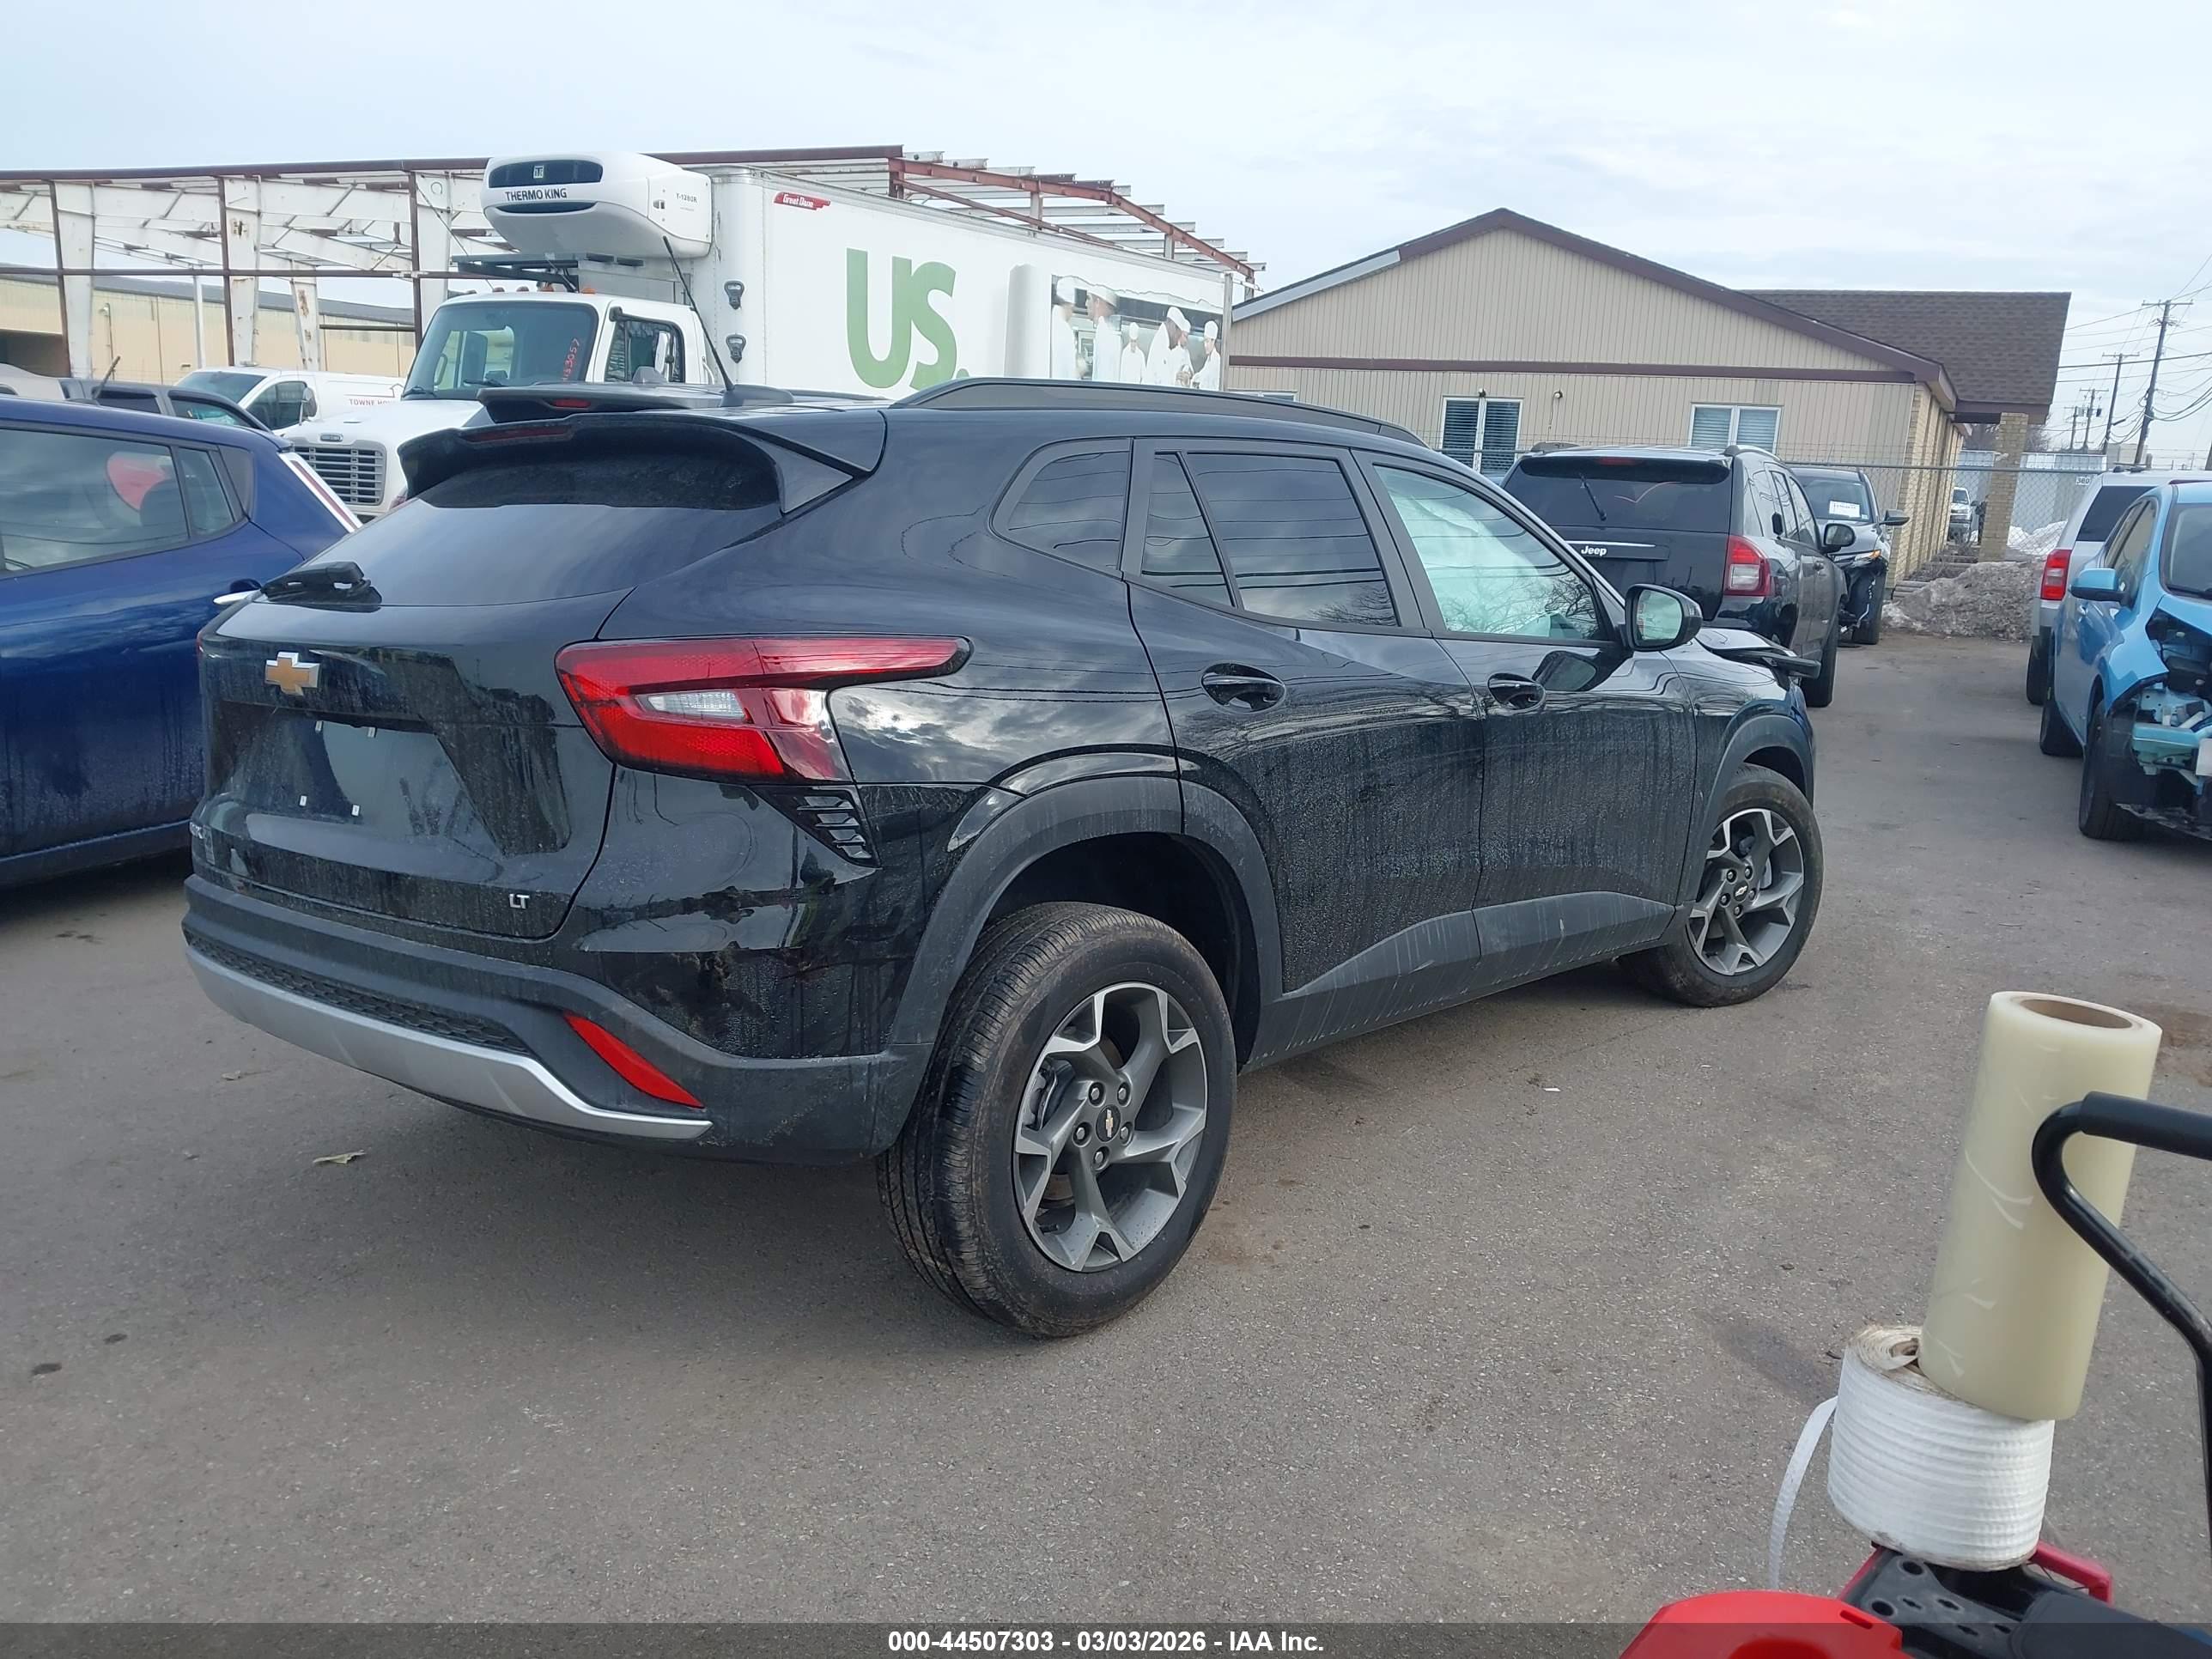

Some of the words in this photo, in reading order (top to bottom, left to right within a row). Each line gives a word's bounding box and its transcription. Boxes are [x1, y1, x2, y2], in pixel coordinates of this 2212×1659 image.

[504, 189, 544, 202] THERMO
[544, 187, 568, 200] KING
[782, 193, 799, 205] Great
[799, 197, 814, 208] Dane
[1581, 545, 1607, 556] Jeep
[508, 893, 530, 909] LT
